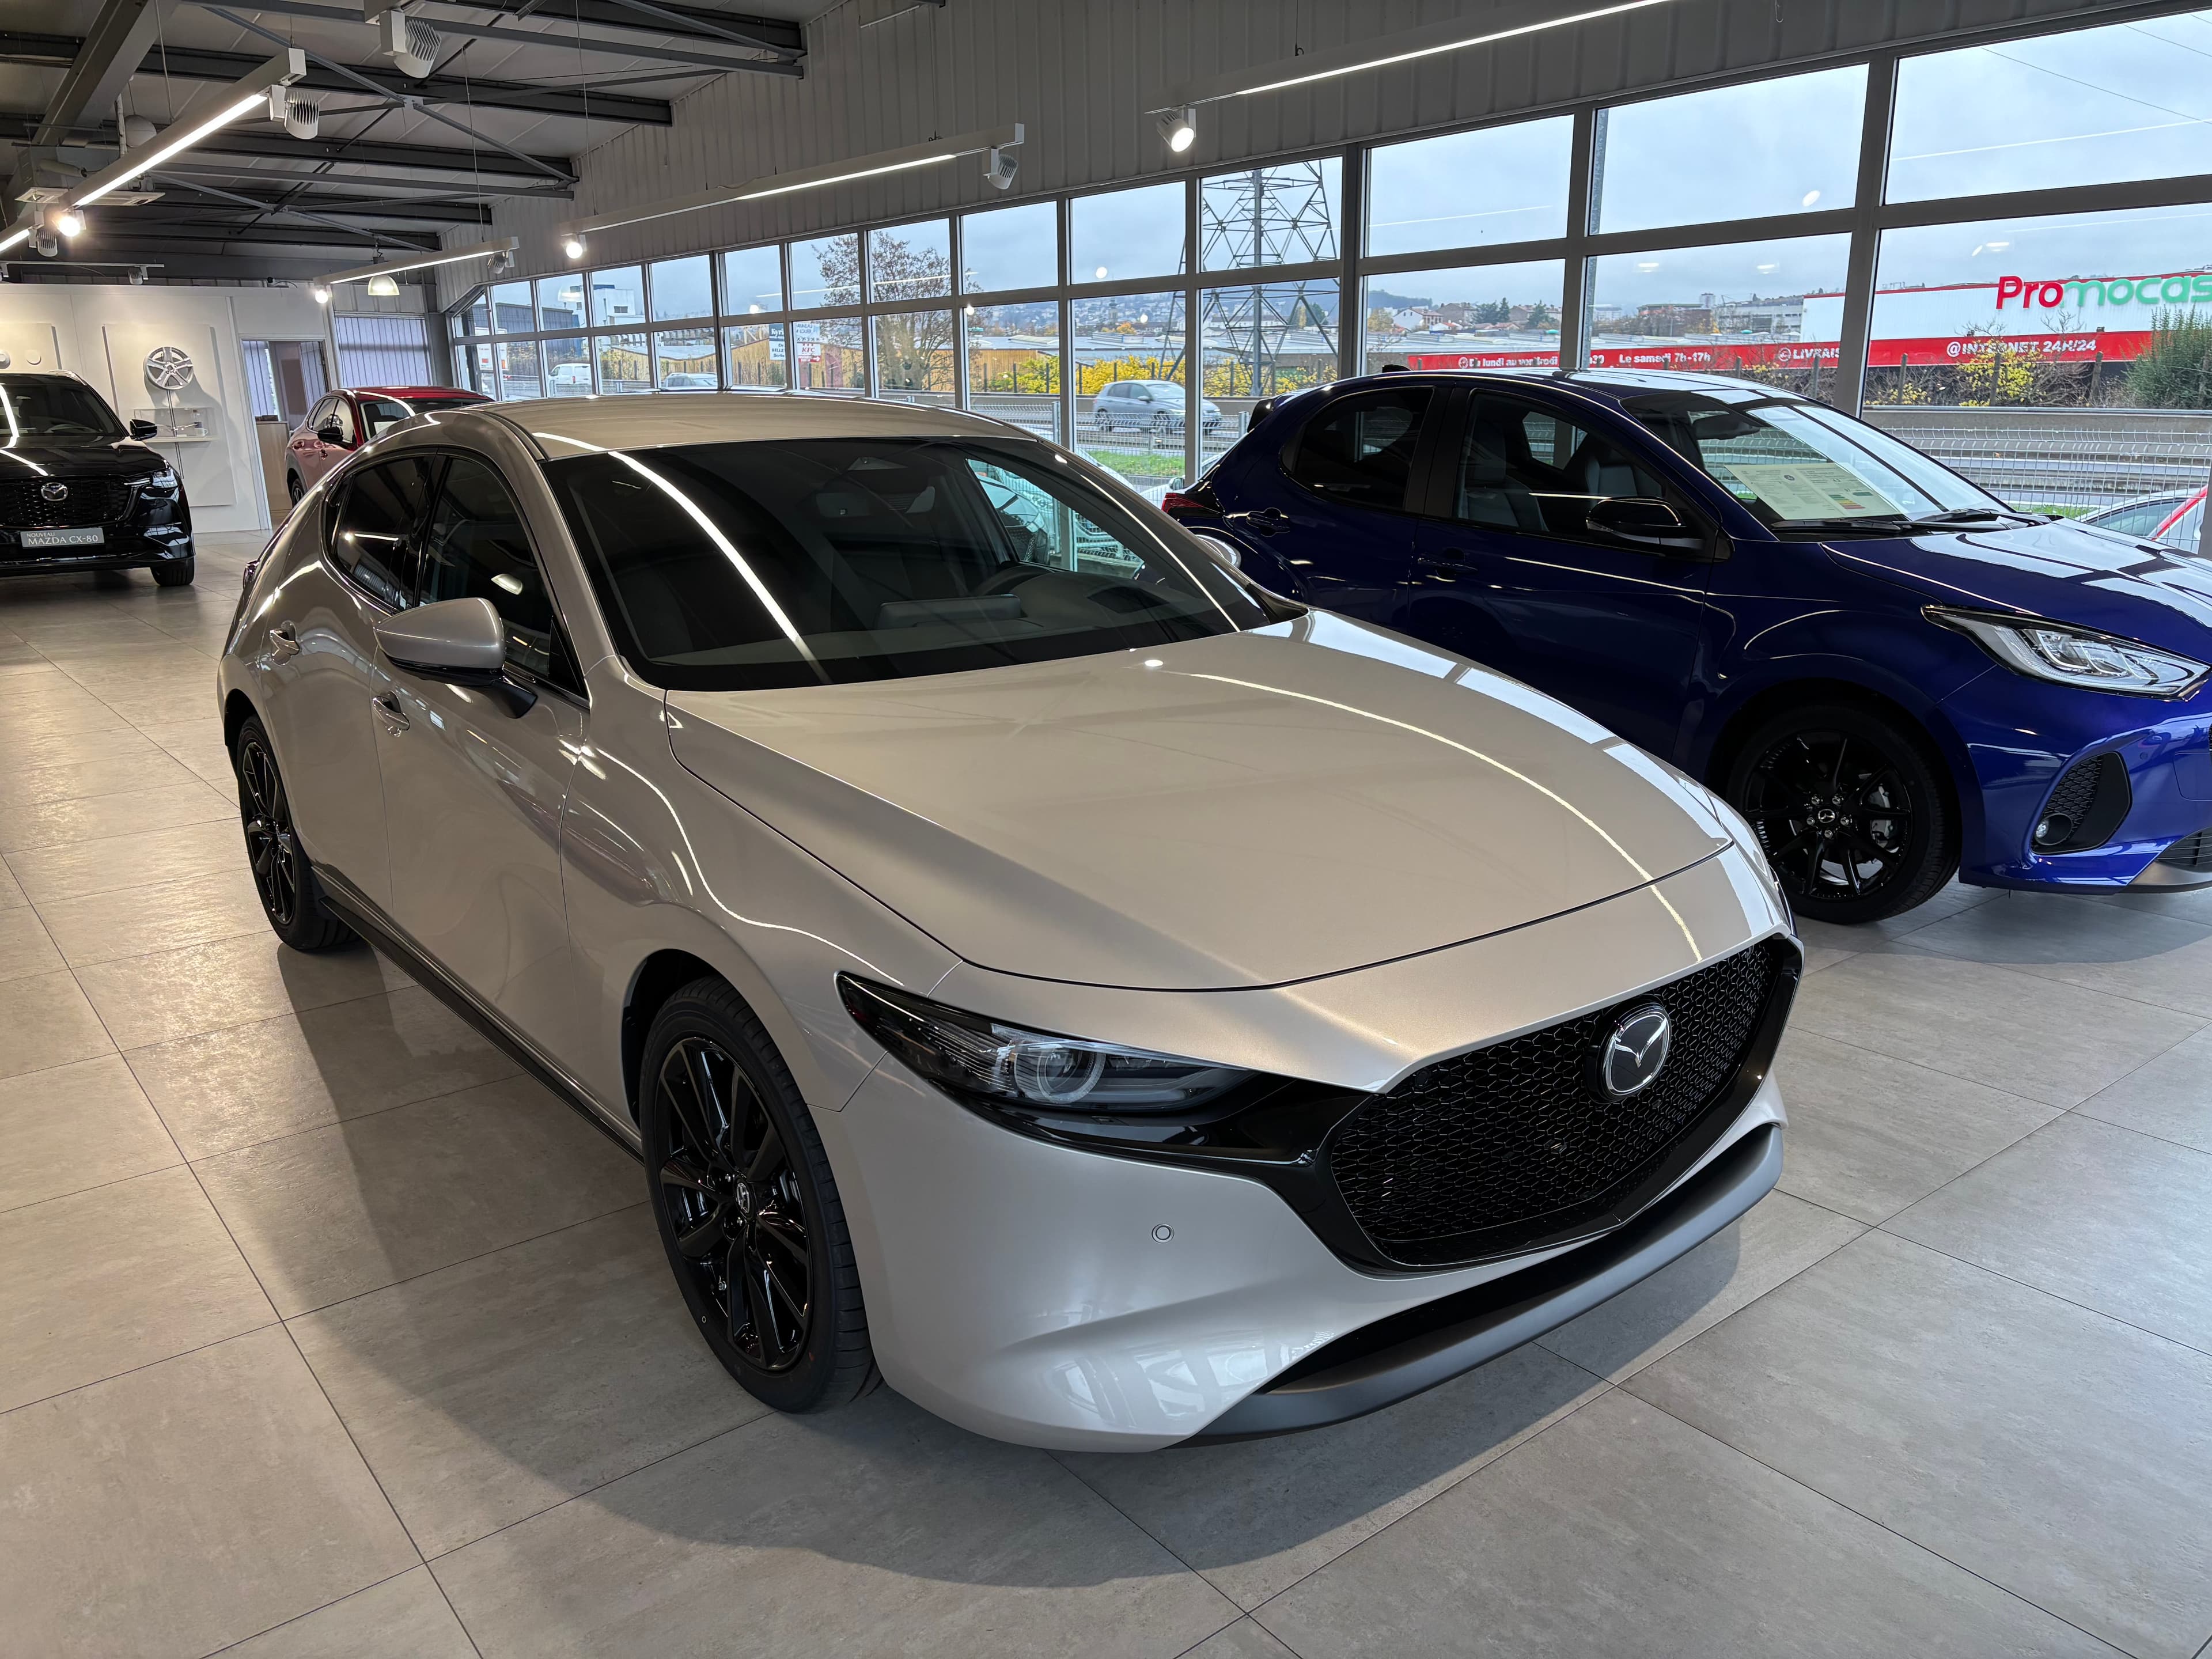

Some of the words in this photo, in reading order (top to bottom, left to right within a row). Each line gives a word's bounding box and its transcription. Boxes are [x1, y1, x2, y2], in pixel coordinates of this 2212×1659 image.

[1996, 275, 2212, 309] Promocas
[1483, 358, 1504, 366] lundi
[1619, 354, 1632, 363] Le
[28, 536, 67, 545] MAZDA
[69, 535, 98, 544] CX-80
